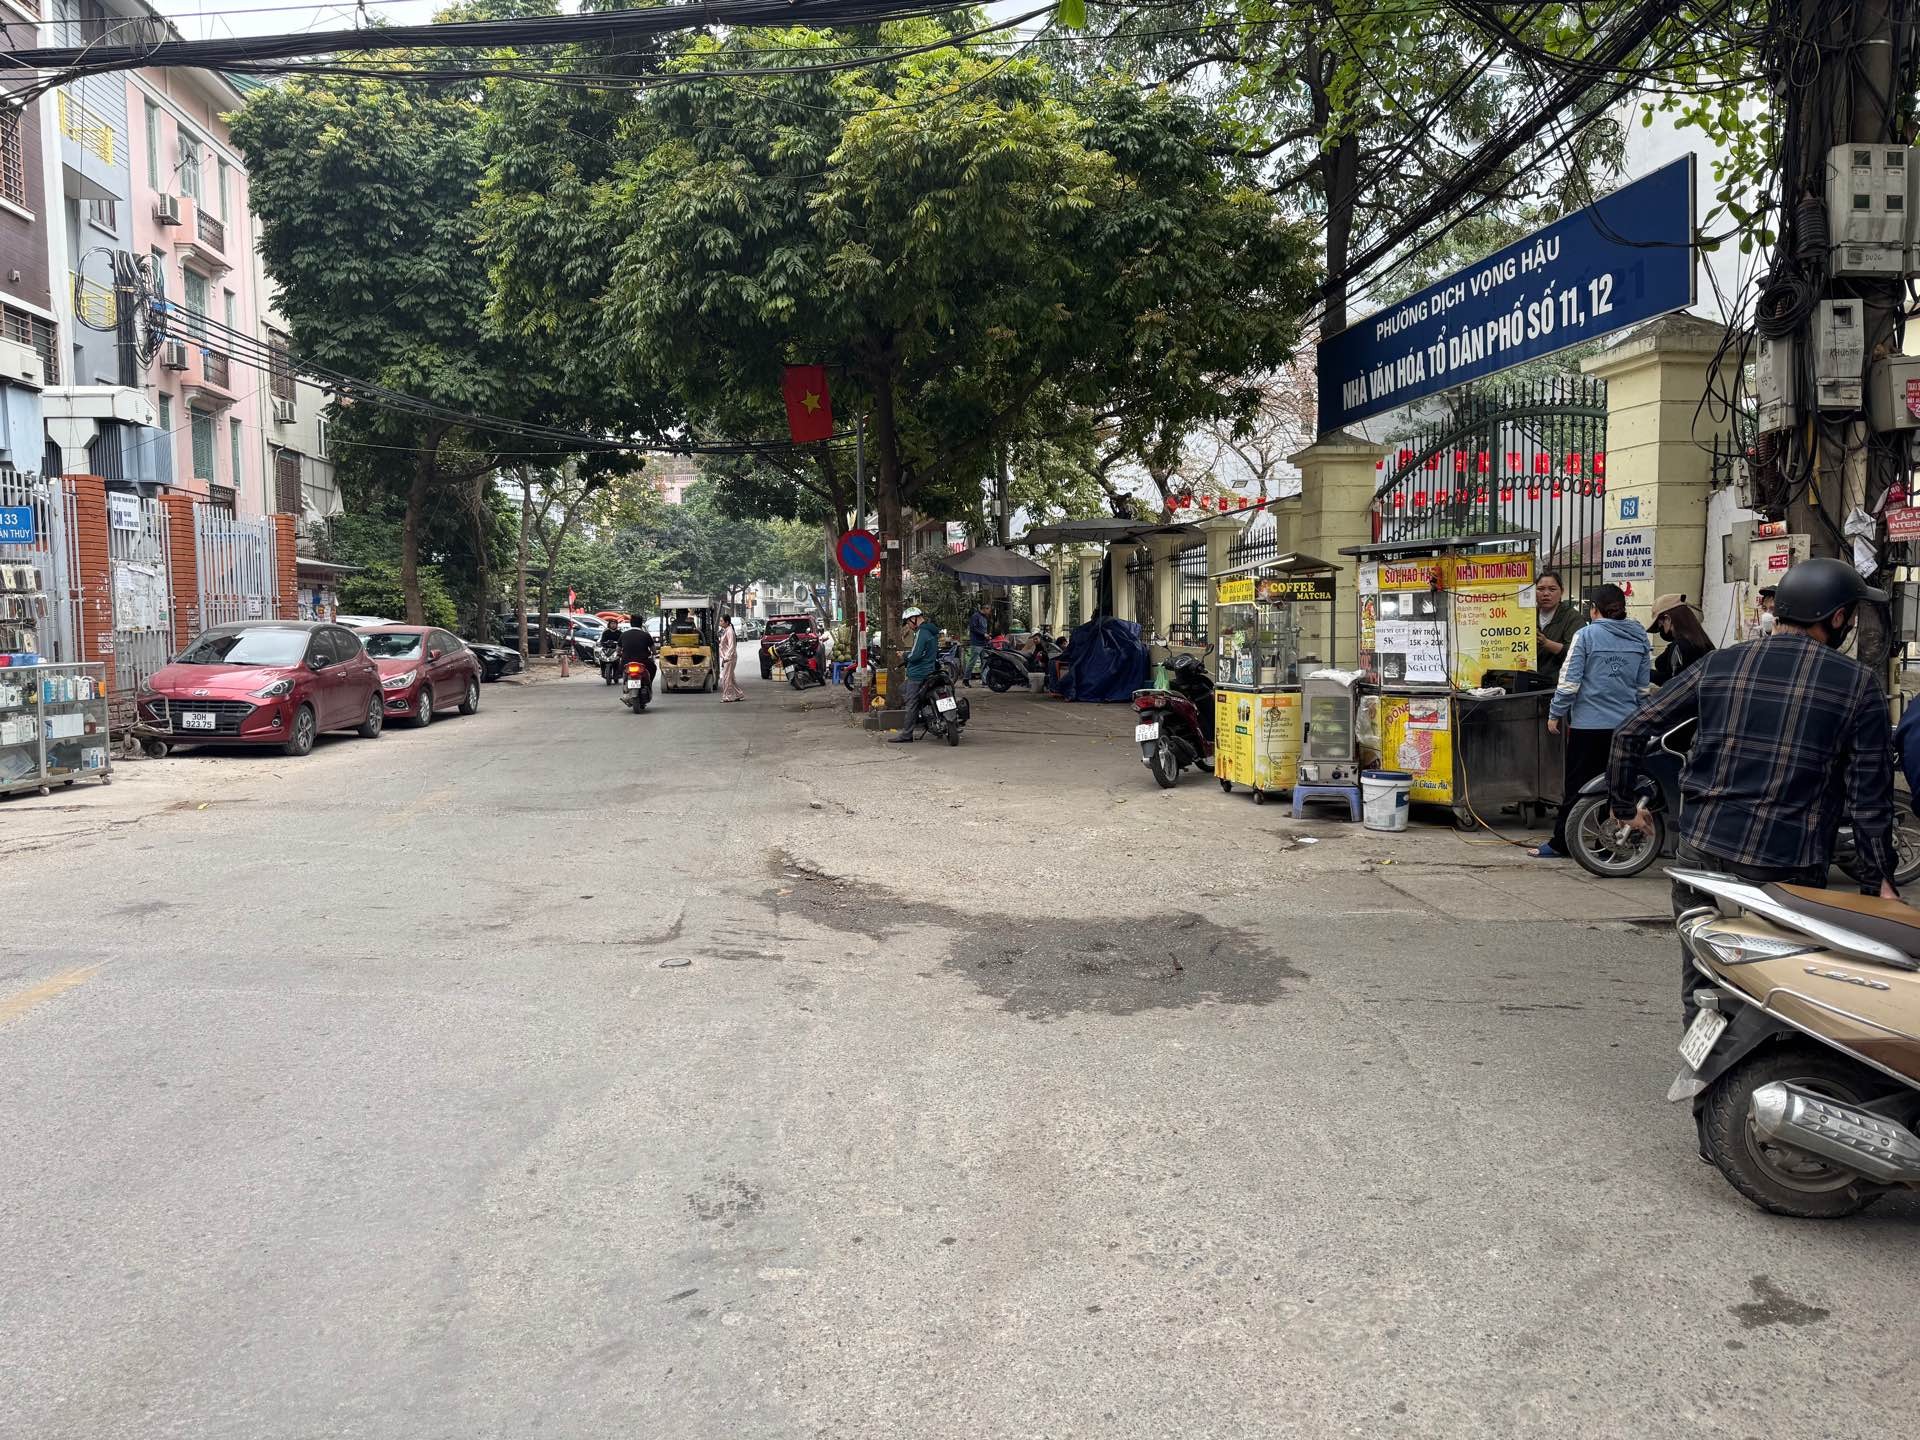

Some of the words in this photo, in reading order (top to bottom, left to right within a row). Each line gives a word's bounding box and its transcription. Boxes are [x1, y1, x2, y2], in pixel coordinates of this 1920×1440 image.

[1376, 300, 1427, 342] PHƯỜNG
[1431, 282, 1465, 315] DỊCH
[1471, 257, 1516, 297] VỌNG
[1521, 236, 1560, 275] HẬU
[1342, 369, 1368, 411] NHÀ
[1369, 361, 1394, 400] VĂN
[1396, 346, 1425, 389] HÓA
[1428, 326, 1446, 378] TỔ
[1449, 326, 1484, 371] DÂN
[1487, 294, 1524, 356] PHỐ
[1527, 280, 1556, 341] SỐ
[1558, 287, 1585, 327] 11,
[1588, 273, 1613, 317] 12
[1623, 500, 1636, 516] 63
[1615, 533, 1642, 546] CẤM
[1606, 547, 1624, 558] BÁN
[1626, 546, 1651, 557] HÀNG
[1641, 558, 1652, 567] XE
[1270, 581, 1316, 593] COFFEE
[1296, 592, 1332, 600] MATCHA
[1456, 592, 1498, 604] COMBO
[1489, 607, 1508, 619] 30k
[1480, 626, 1521, 638] COMBO
[1524, 626, 1531, 636] 2
[1383, 636, 1395, 645] 5K
[1511, 641, 1529, 653] 25k
[191, 713, 207, 721] 30H
[186, 720, 212, 729] 923.75
[1803, 966, 1891, 990] LEAD
